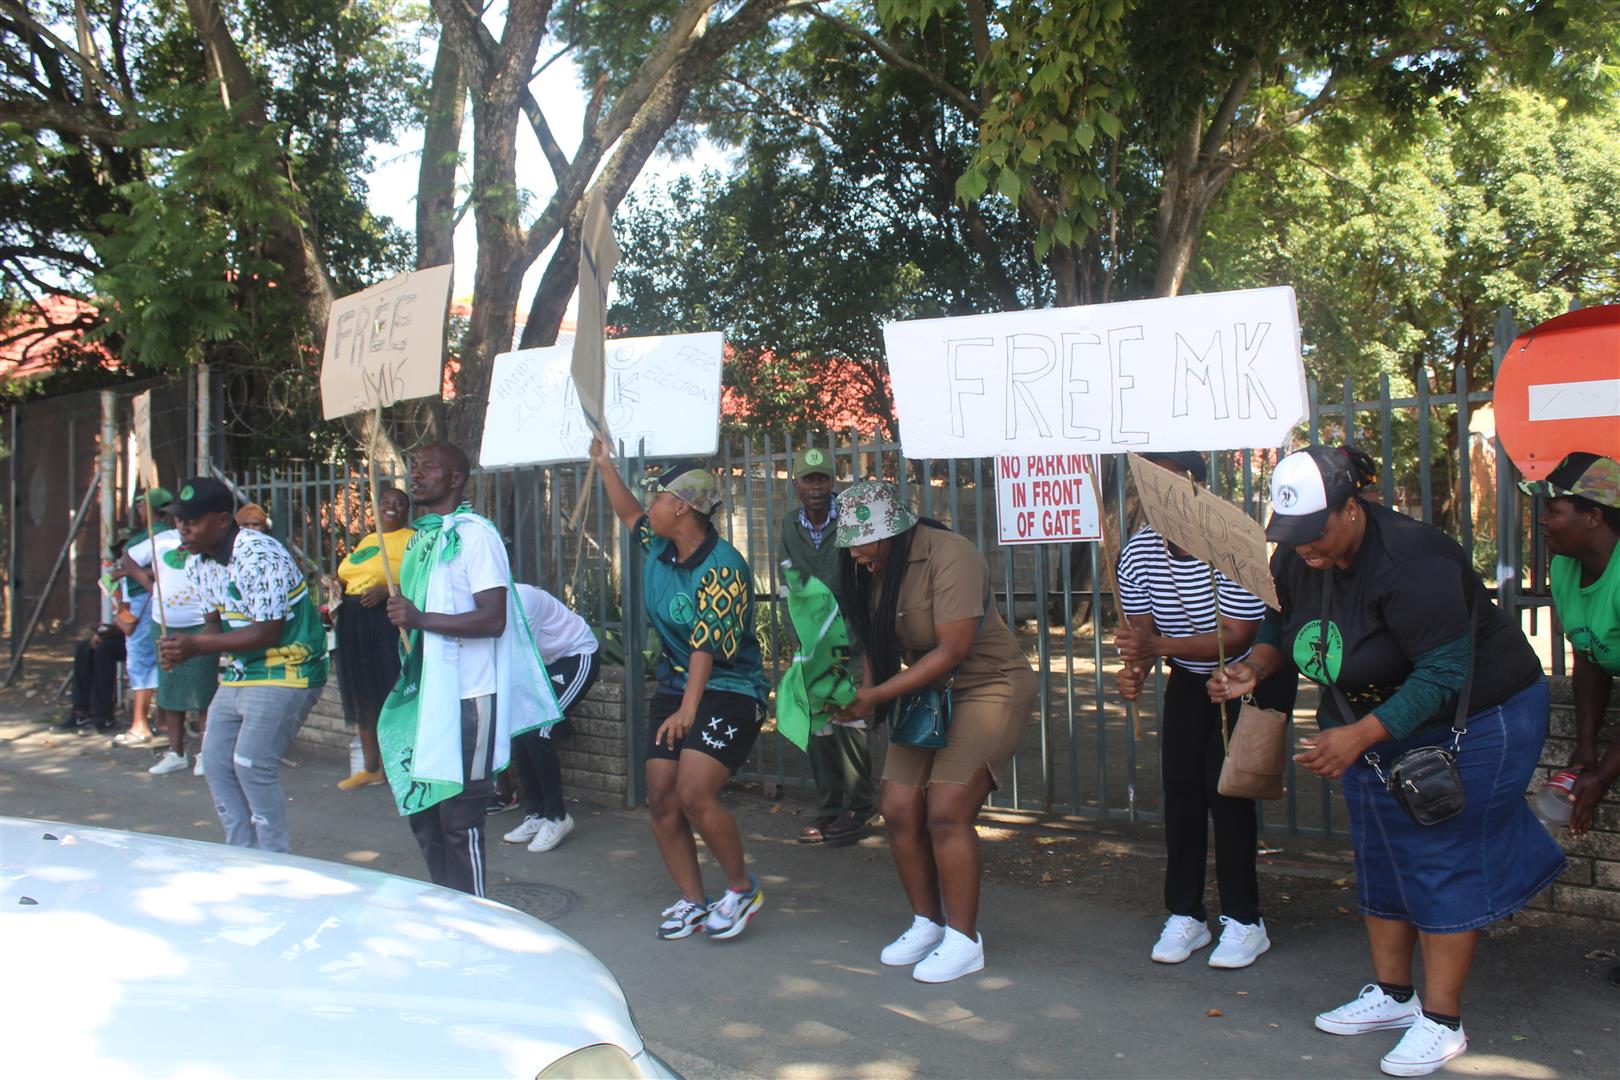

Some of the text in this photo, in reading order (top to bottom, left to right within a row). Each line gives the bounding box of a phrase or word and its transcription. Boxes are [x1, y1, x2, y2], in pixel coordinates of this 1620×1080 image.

[332, 293, 418, 368] FREE
[361, 356, 409, 406] MK
[672, 344, 717, 373] FREE
[946, 322, 1278, 445] FREE MK
[512, 368, 565, 432] ZUM
[1001, 455, 1021, 479] NO
[1012, 478, 1083, 508] IN FRONT
[1138, 463, 1252, 556] HANDS
[1017, 508, 1082, 538] OF GATE
